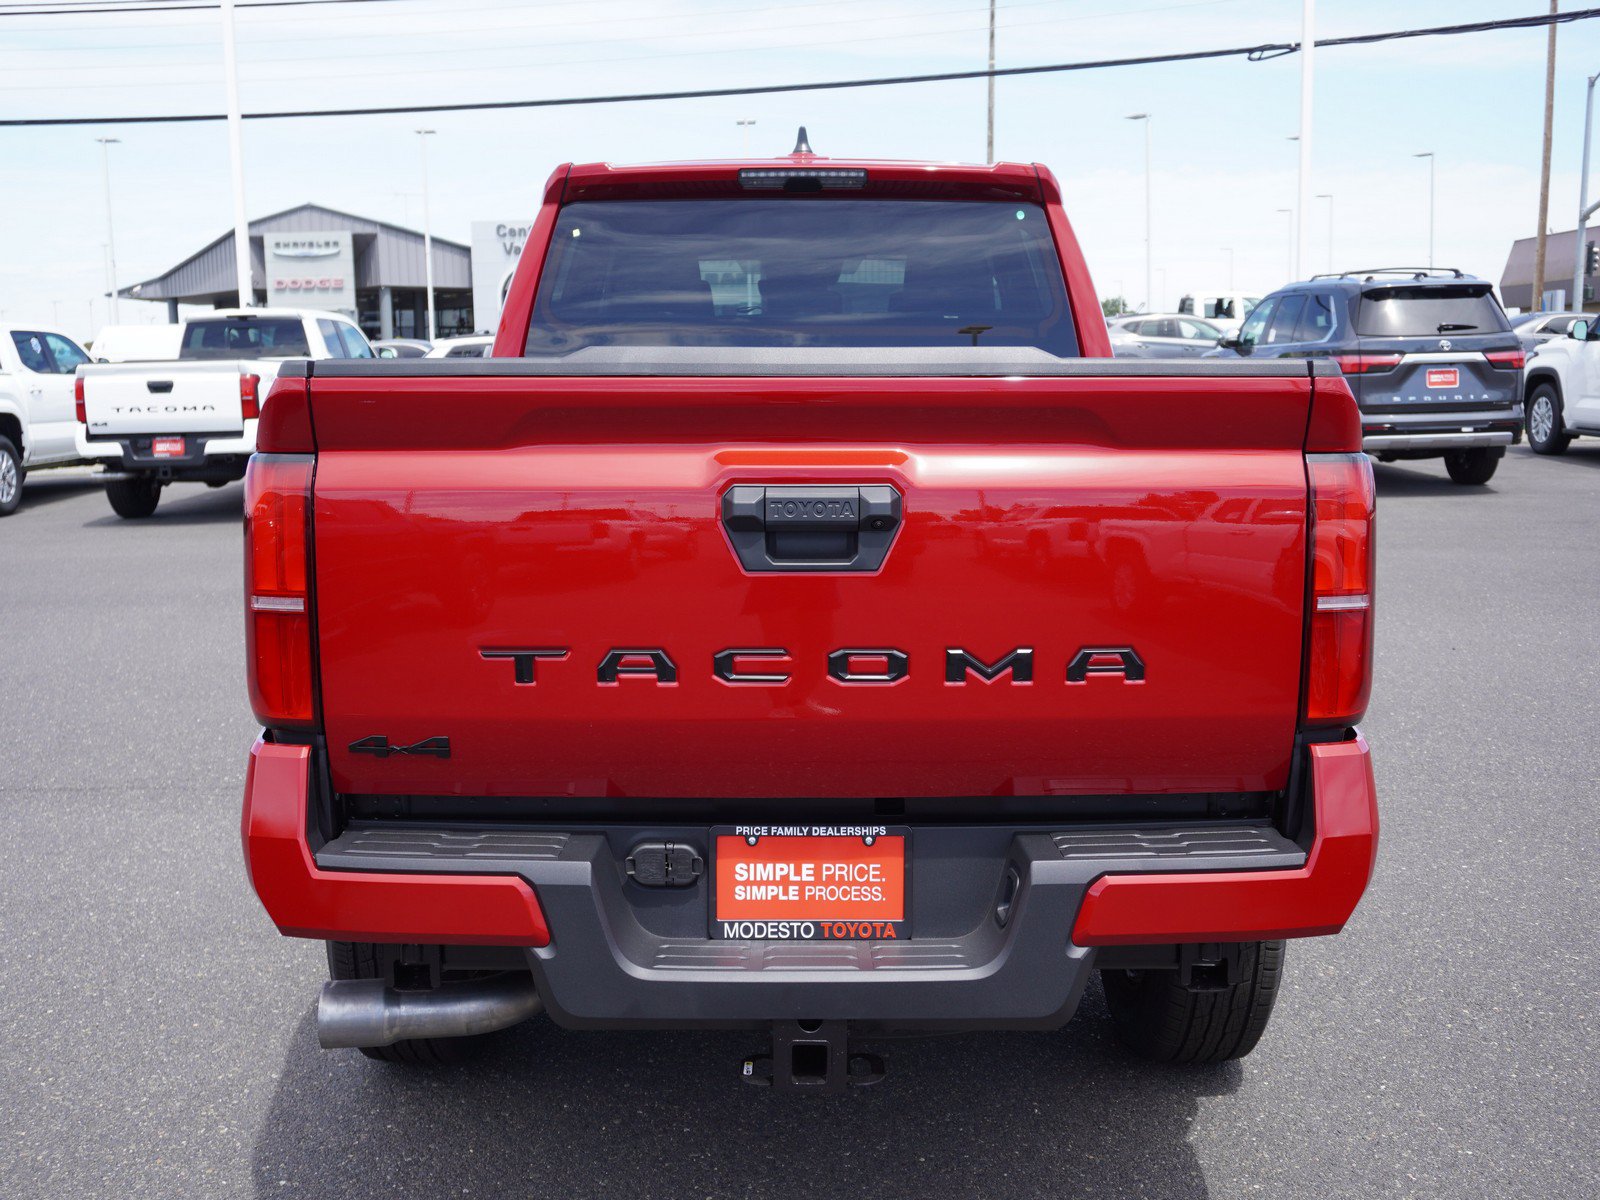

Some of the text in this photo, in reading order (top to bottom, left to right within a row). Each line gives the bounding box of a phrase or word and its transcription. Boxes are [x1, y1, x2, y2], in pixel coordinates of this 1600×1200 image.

[496, 223, 533, 238] Cen
[274, 279, 344, 290] DODGE
[111, 405, 215, 413] TACOMA
[770, 500, 855, 518] TOYOTA
[479, 646, 1147, 687] TACOMA
[735, 826, 887, 836] PRICE FAMILY DEALERSHIPS
[734, 863, 886, 882] SIMPLE PRICE.
[734, 886, 886, 901] SIMPLE PROCESS.
[724, 922, 897, 939] MODESTO TOYOTA
